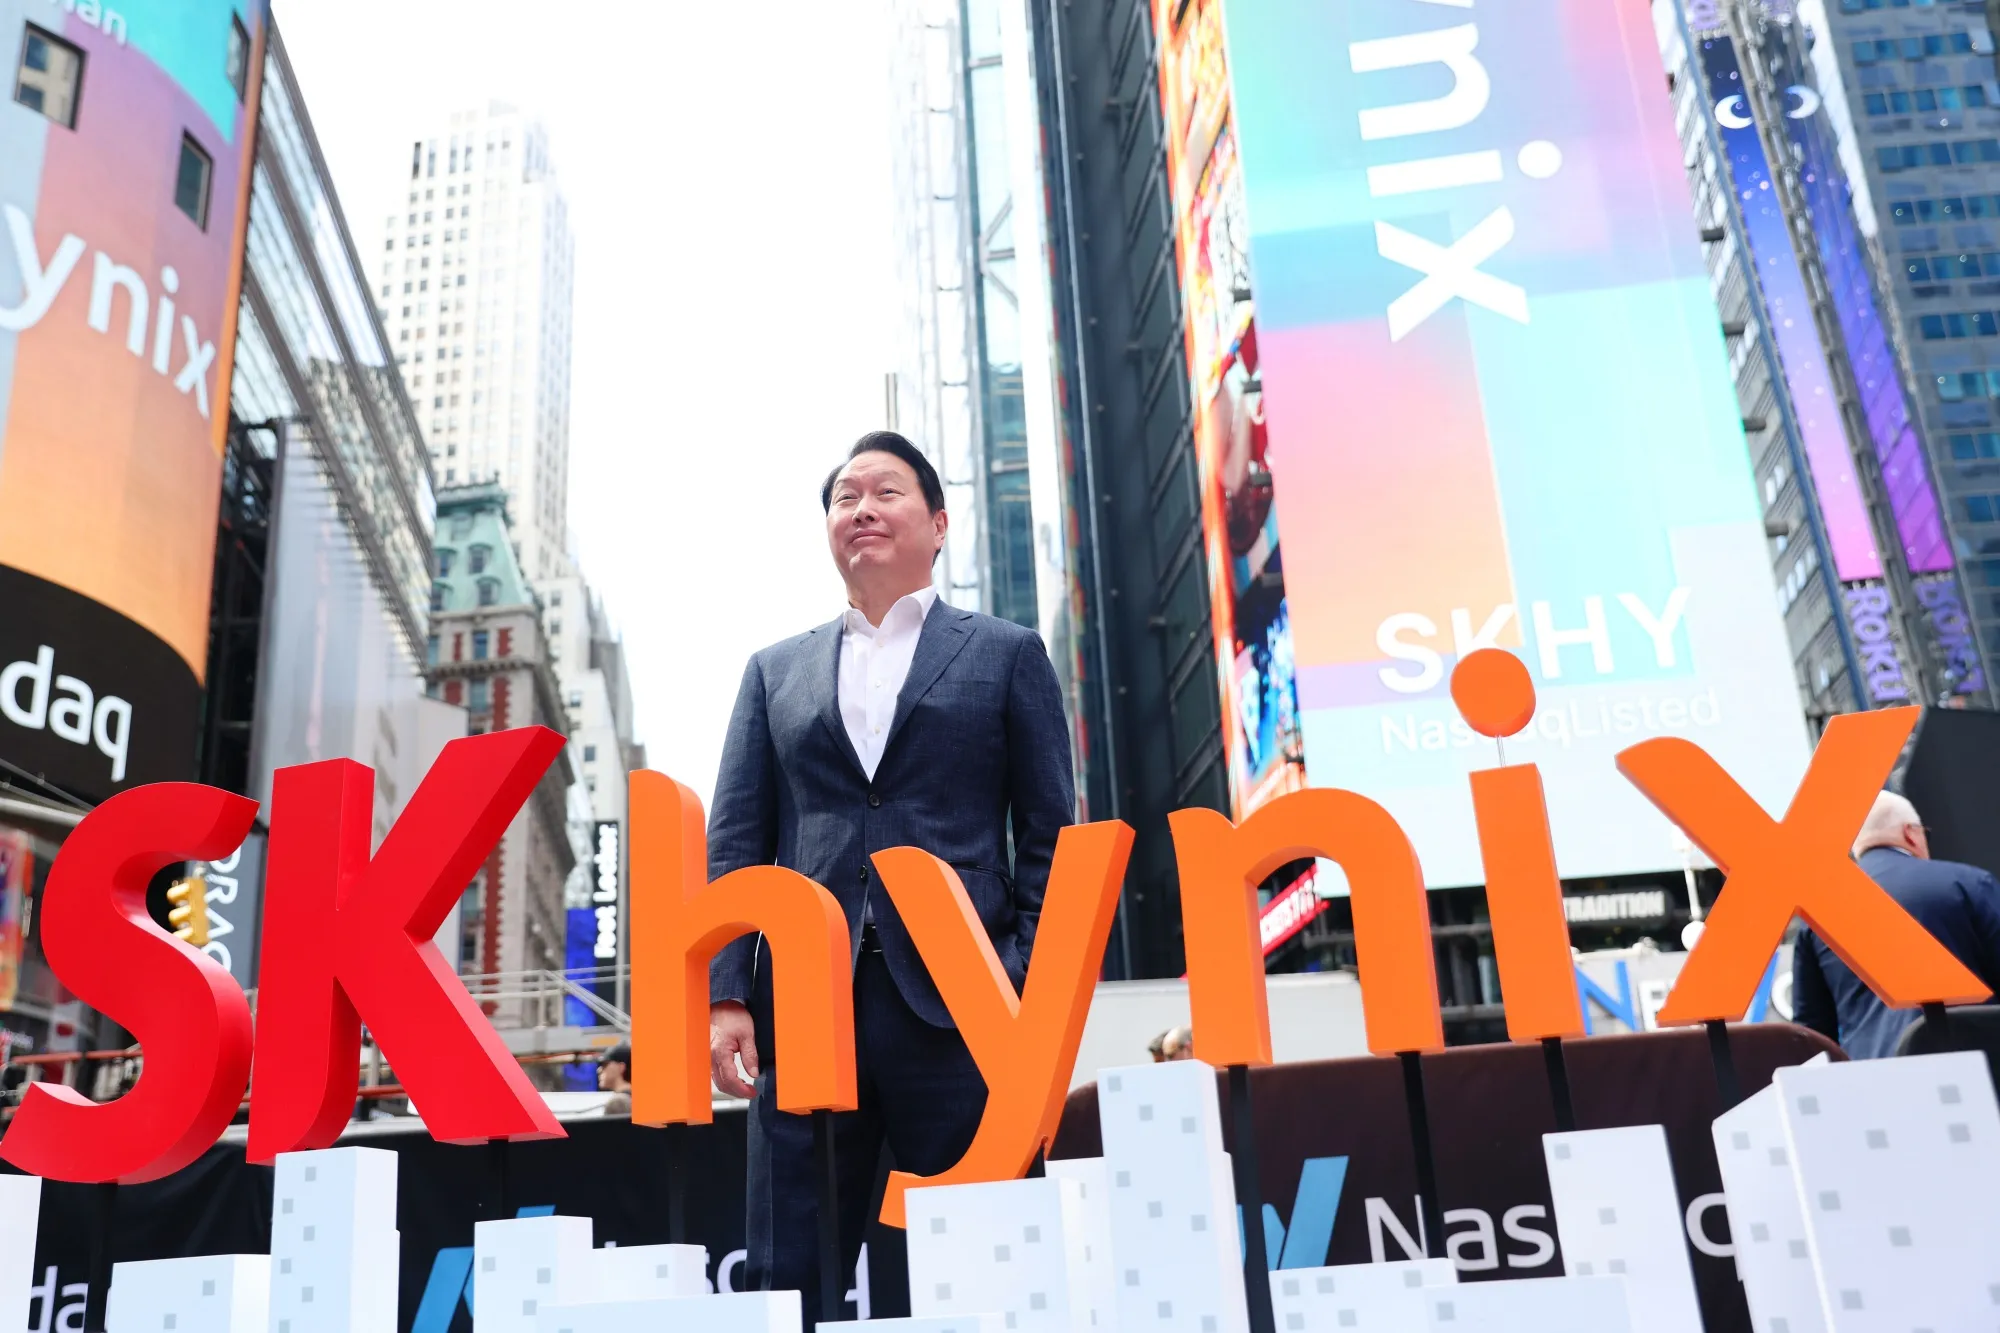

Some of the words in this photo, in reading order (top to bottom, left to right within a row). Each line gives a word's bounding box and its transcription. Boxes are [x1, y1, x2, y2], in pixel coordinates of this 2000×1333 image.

[1348, 0, 1563, 343] nix
[0, 208, 216, 418] ynix
[0, 643, 133, 783] daq
[1380, 685, 1722, 755] NasqListed
[1847, 585, 1909, 701] ROKU
[0, 727, 567, 1186] SK
[630, 648, 1993, 1229] hynix
